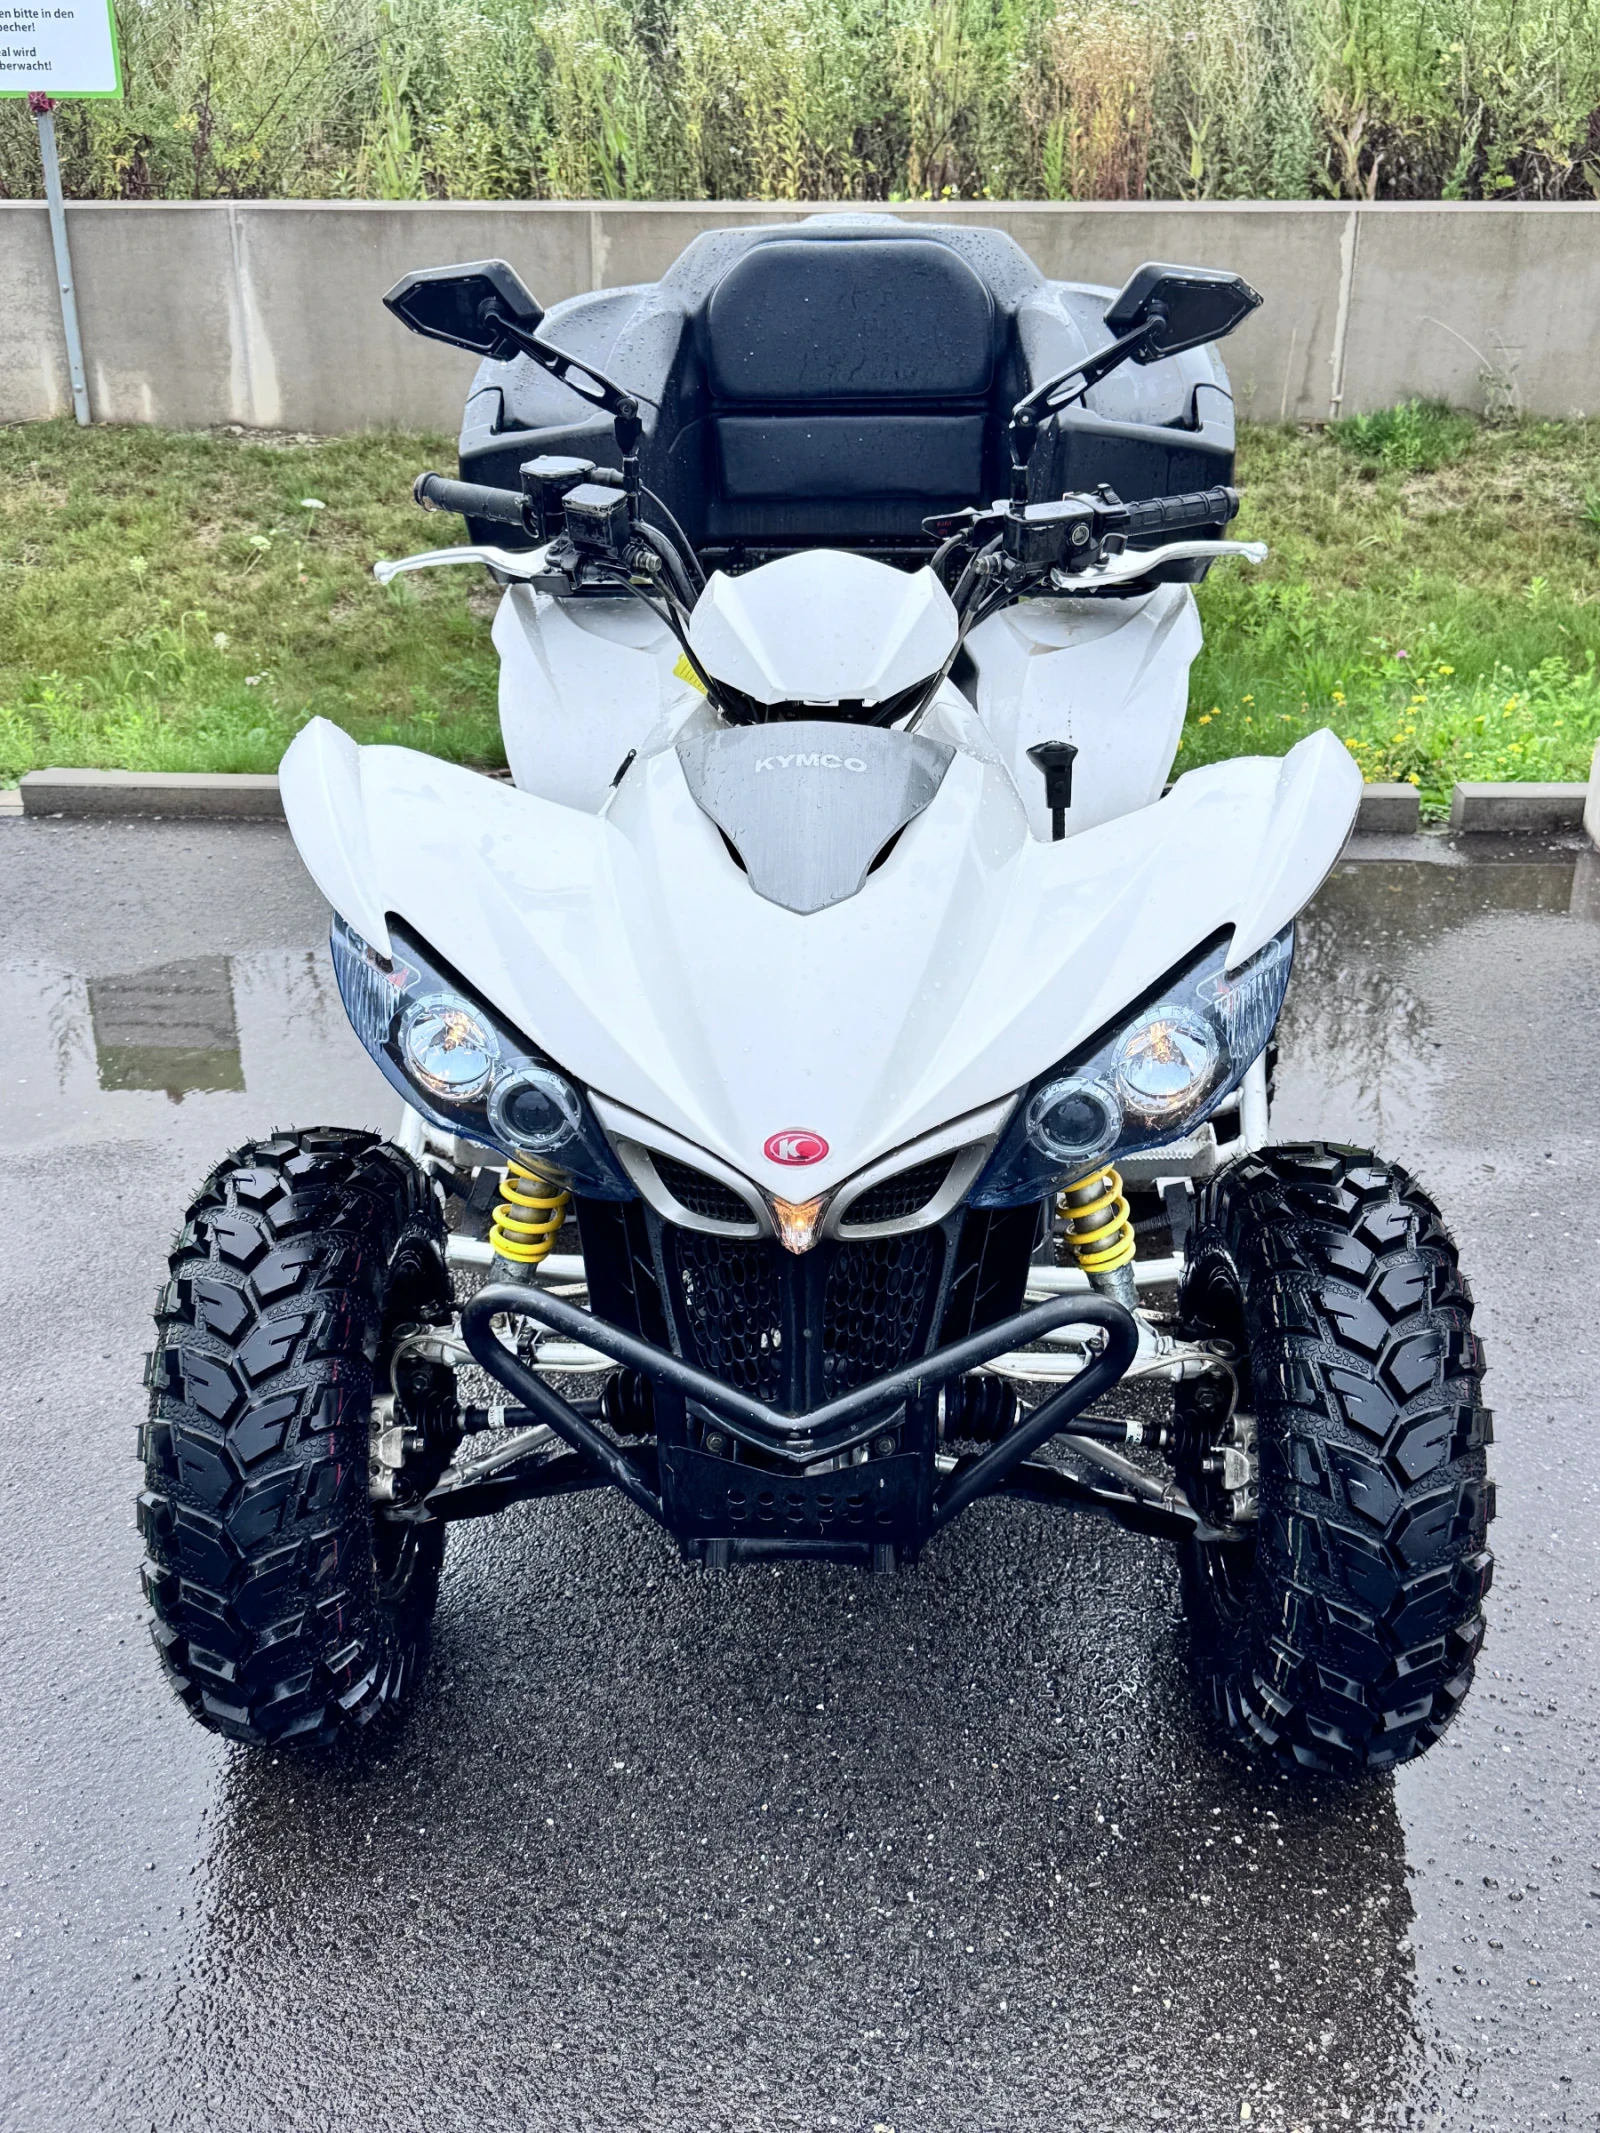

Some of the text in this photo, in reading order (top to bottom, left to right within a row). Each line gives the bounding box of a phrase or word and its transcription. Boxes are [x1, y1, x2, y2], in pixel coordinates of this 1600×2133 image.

[13, 8, 39, 18] bitte
[41, 8, 52, 18] in
[54, 8, 74, 18] den
[13, 47, 37, 57] wird
[755, 753, 868, 773] KYMCO
